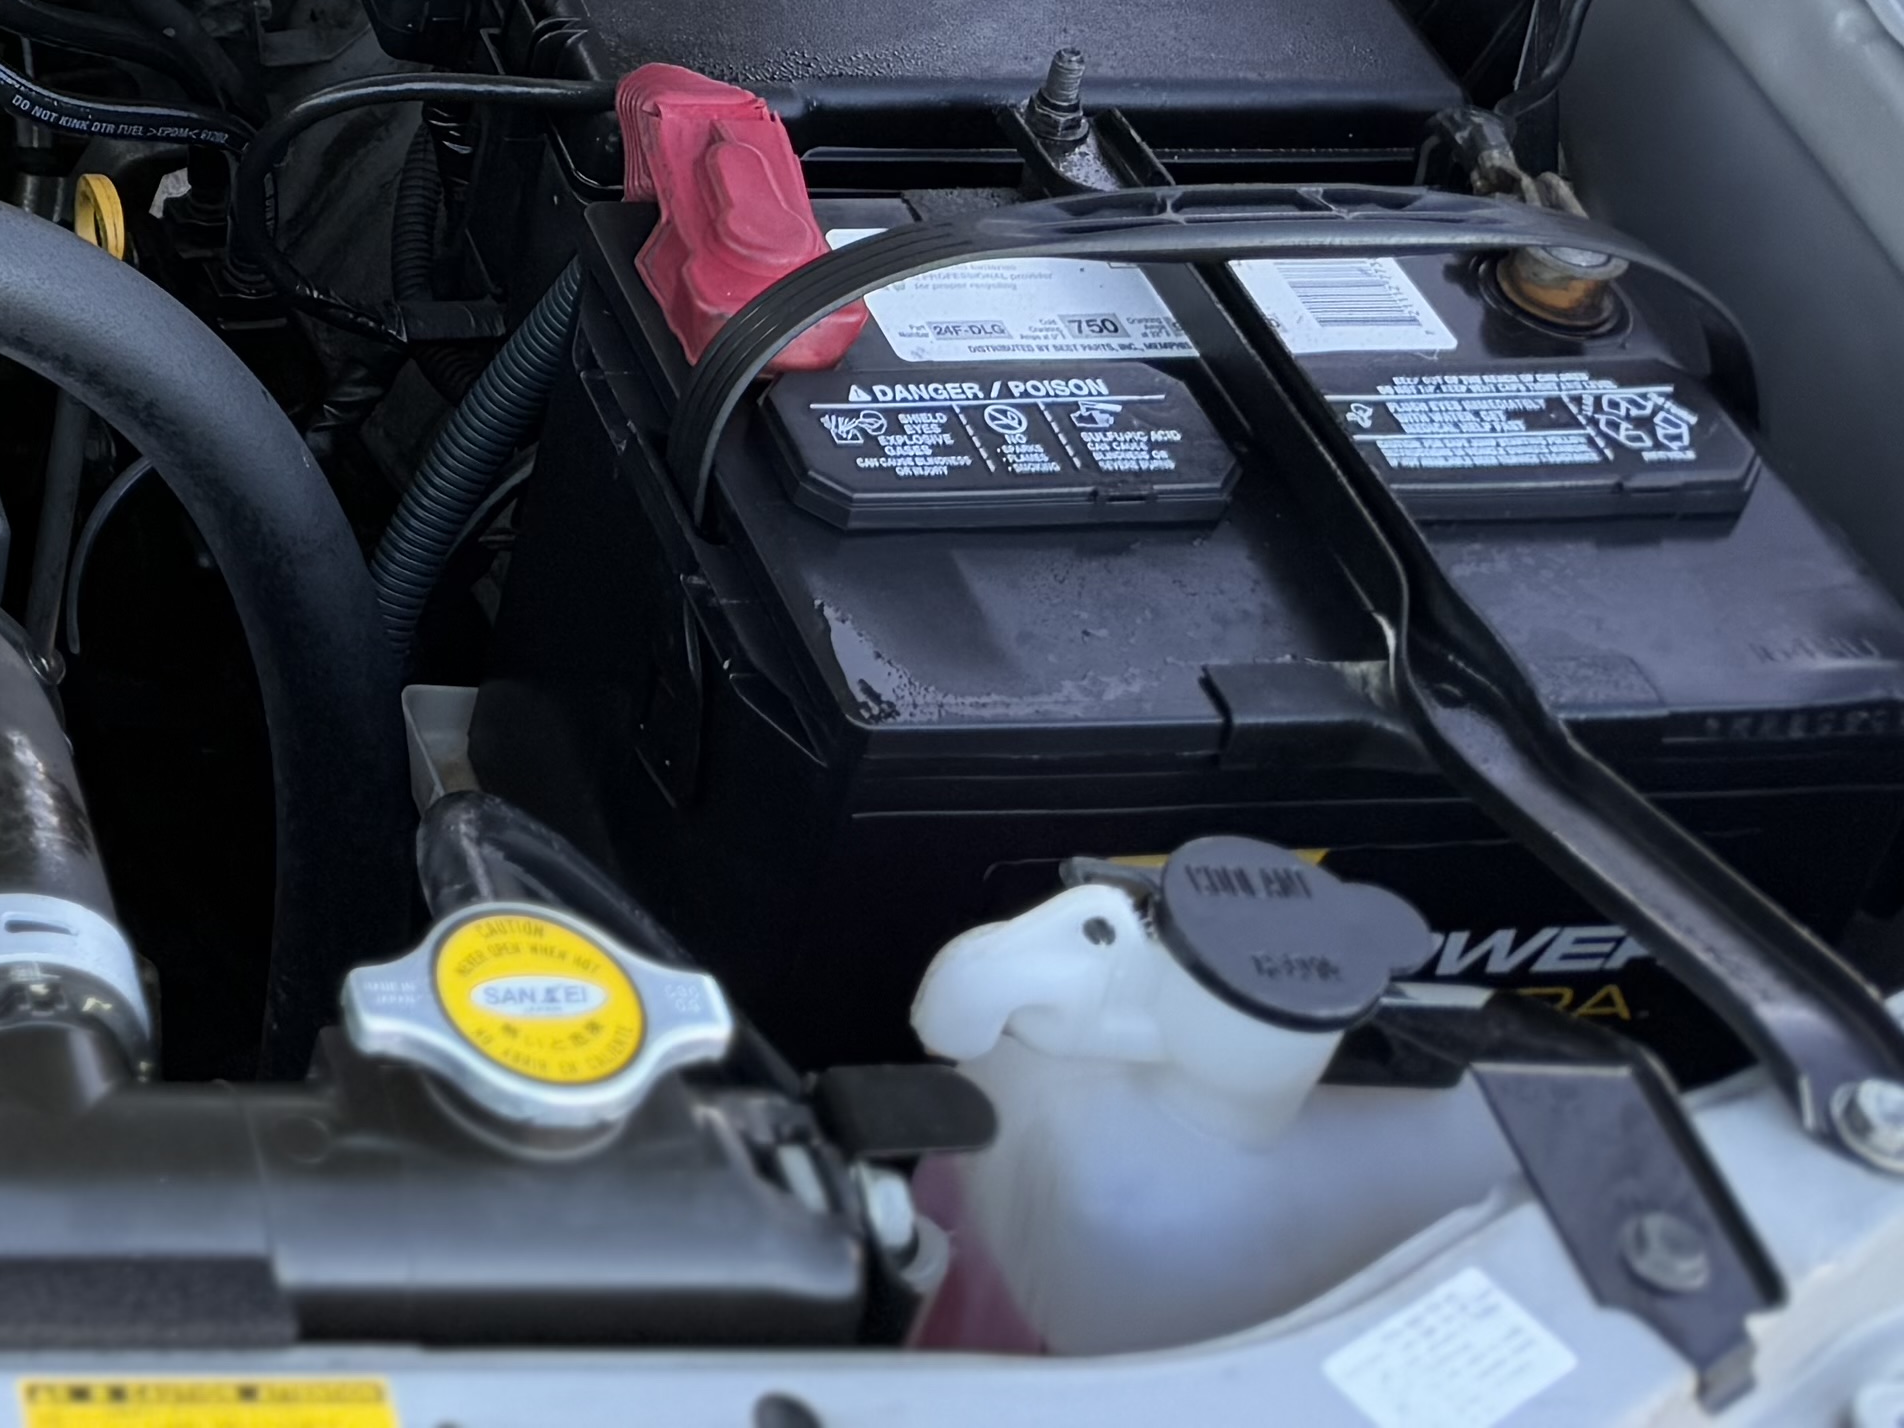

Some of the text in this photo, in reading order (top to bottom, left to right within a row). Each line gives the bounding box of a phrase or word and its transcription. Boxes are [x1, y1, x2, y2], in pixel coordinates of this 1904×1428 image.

[11, 94, 31, 111] DO
[31, 105, 59, 122] NOT
[58, 115, 90, 131] KINK
[117, 124, 146, 137] FUEL
[1068, 318, 1119, 335] 750
[967, 344, 1033, 354] DISTRIBUTED
[1035, 344, 1050, 353] BY
[871, 379, 1110, 402] DANGER / POISON
[897, 412, 948, 425] SHIELD
[905, 423, 942, 434] EYES
[876, 434, 955, 446] EXPLOSIVE
[1004, 433, 1028, 444] NO
[1080, 430, 1182, 443] SULFURIC ACID
[884, 445, 933, 456] GASES
[476, 919, 545, 939] CAUTION
[487, 941, 521, 958] OPEN
[527, 941, 568, 962] WHEN
[482, 985, 588, 1005] SANKEI
